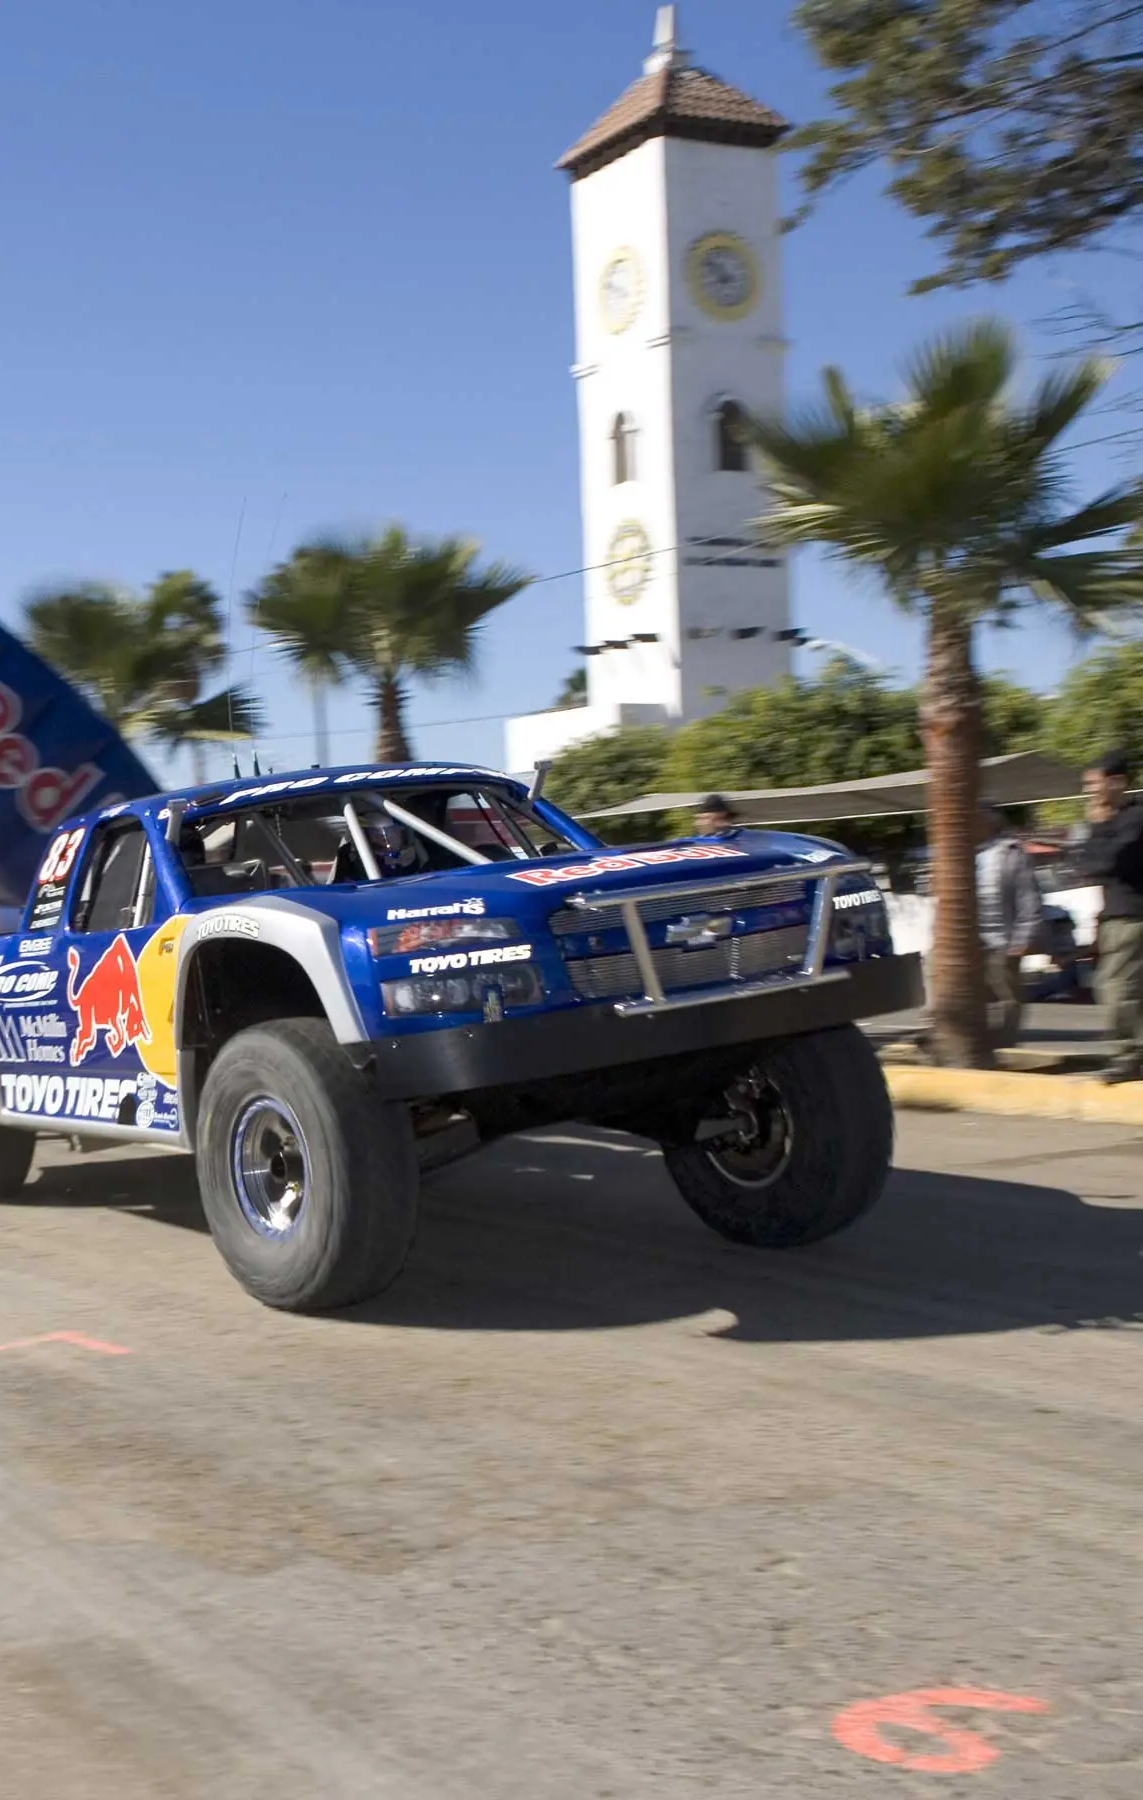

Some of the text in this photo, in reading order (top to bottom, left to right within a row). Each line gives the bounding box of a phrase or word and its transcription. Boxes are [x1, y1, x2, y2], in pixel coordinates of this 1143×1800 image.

[219, 776, 329, 806] PRO
[37, 826, 86, 884] 83
[504, 845, 749, 887] Red Bull
[832, 893, 861, 910] TOYO
[197, 913, 260, 941] TOYO TIRES
[409, 944, 532, 974] TOYO TIRES
[14, 971, 58, 992] COMP
[26, 1039, 66, 1063] Homes
[0, 1073, 65, 1115] TOYO
